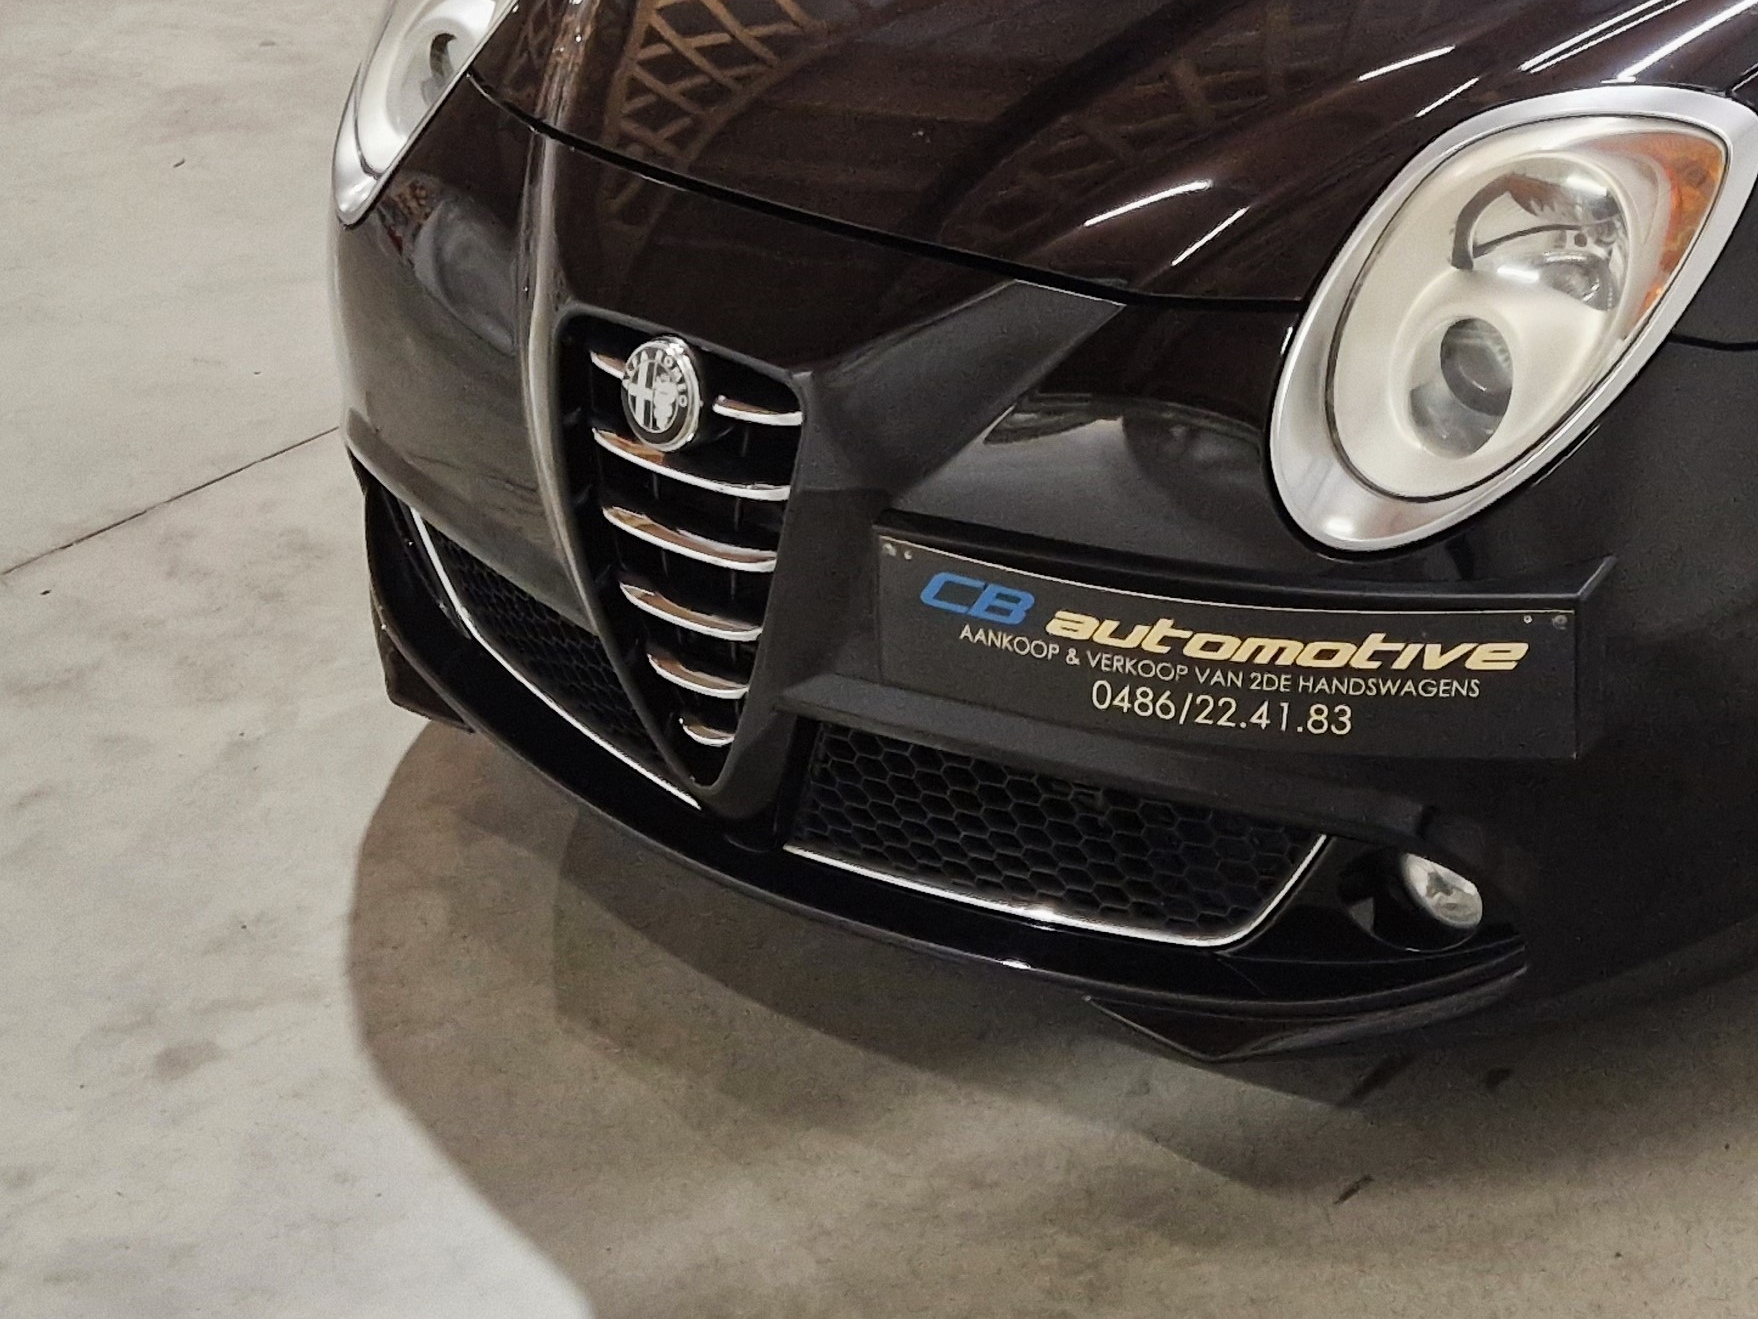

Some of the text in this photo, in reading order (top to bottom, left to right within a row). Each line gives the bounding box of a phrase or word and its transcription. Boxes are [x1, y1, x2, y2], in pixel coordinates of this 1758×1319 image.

[920, 571, 1529, 670] CB automotive
[959, 623, 1480, 698] AANKOOP & VERKOOP VAN 2DE HANDSWAGENS
[1091, 680, 1352, 735] 0486/22.41.83
